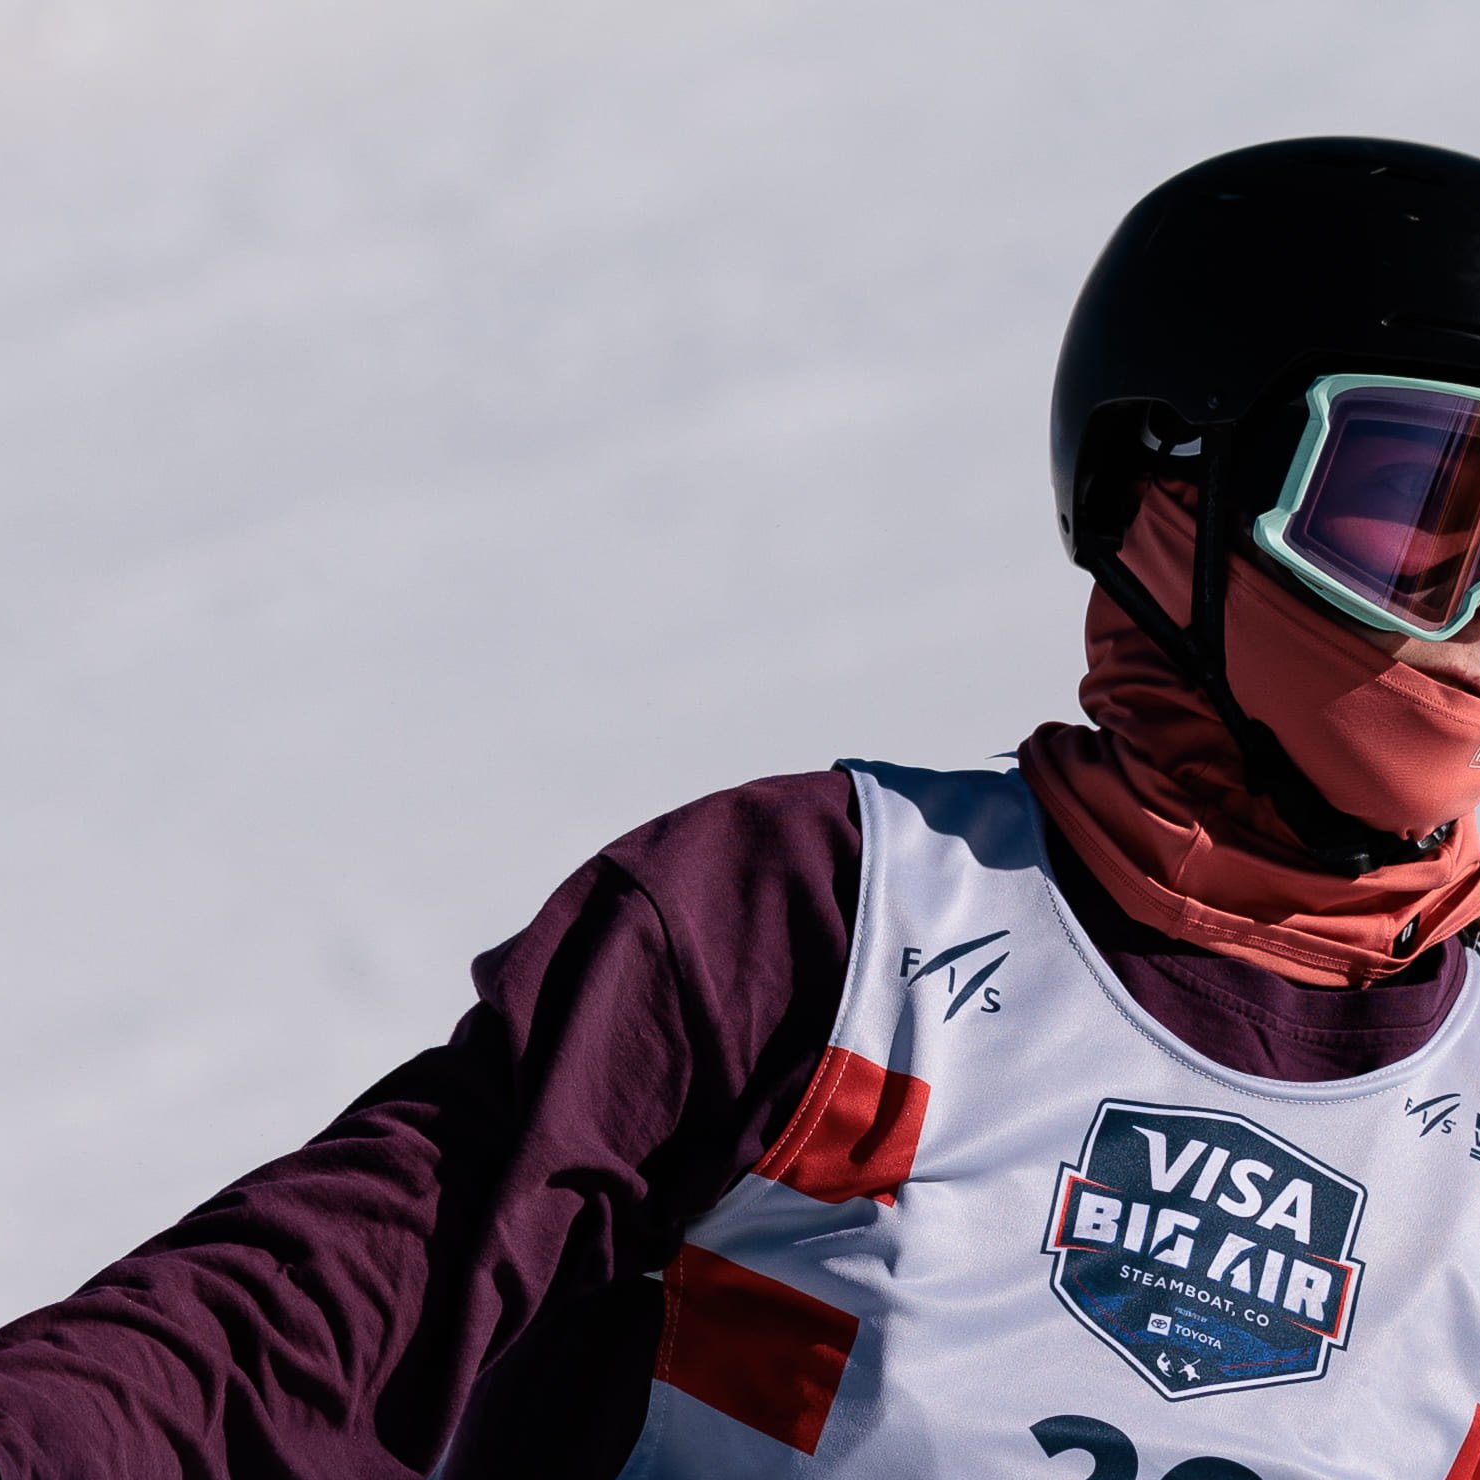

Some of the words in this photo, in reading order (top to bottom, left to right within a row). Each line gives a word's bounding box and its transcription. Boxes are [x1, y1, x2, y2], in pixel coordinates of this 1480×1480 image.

[1132, 1125, 1313, 1245] VISA
[1073, 1191, 1201, 1269] BIG
[1207, 1232, 1332, 1322] AIR
[1119, 1264, 1236, 1317] STEAMBOAT,
[1243, 1308, 1269, 1327] CO
[1174, 1323, 1222, 1350] TOYOTA
